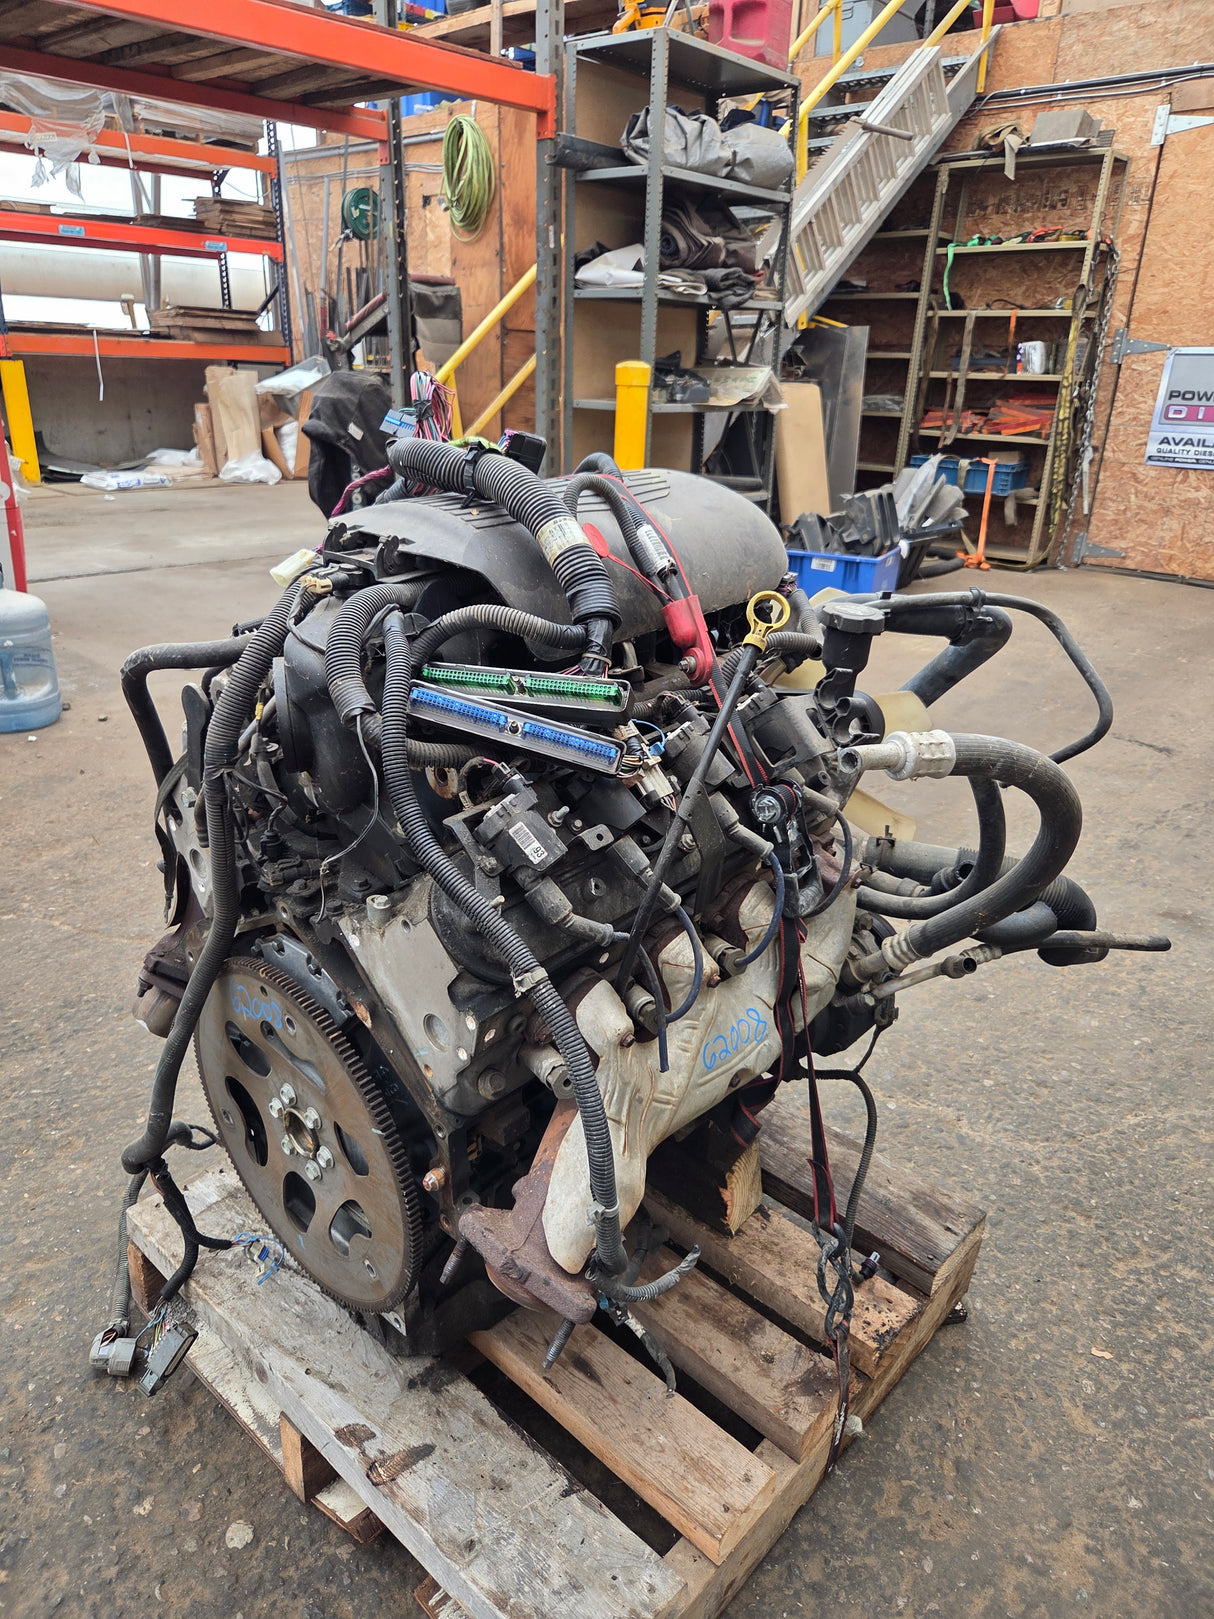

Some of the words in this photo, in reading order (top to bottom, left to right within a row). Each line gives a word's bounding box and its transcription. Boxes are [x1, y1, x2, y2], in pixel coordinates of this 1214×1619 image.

[1168, 390, 1214, 401] POW
[1159, 437, 1214, 448] AVAIL
[533, 846, 545, 858] 93
[230, 979, 282, 1029] 62008
[703, 1008, 767, 1070] 62008
